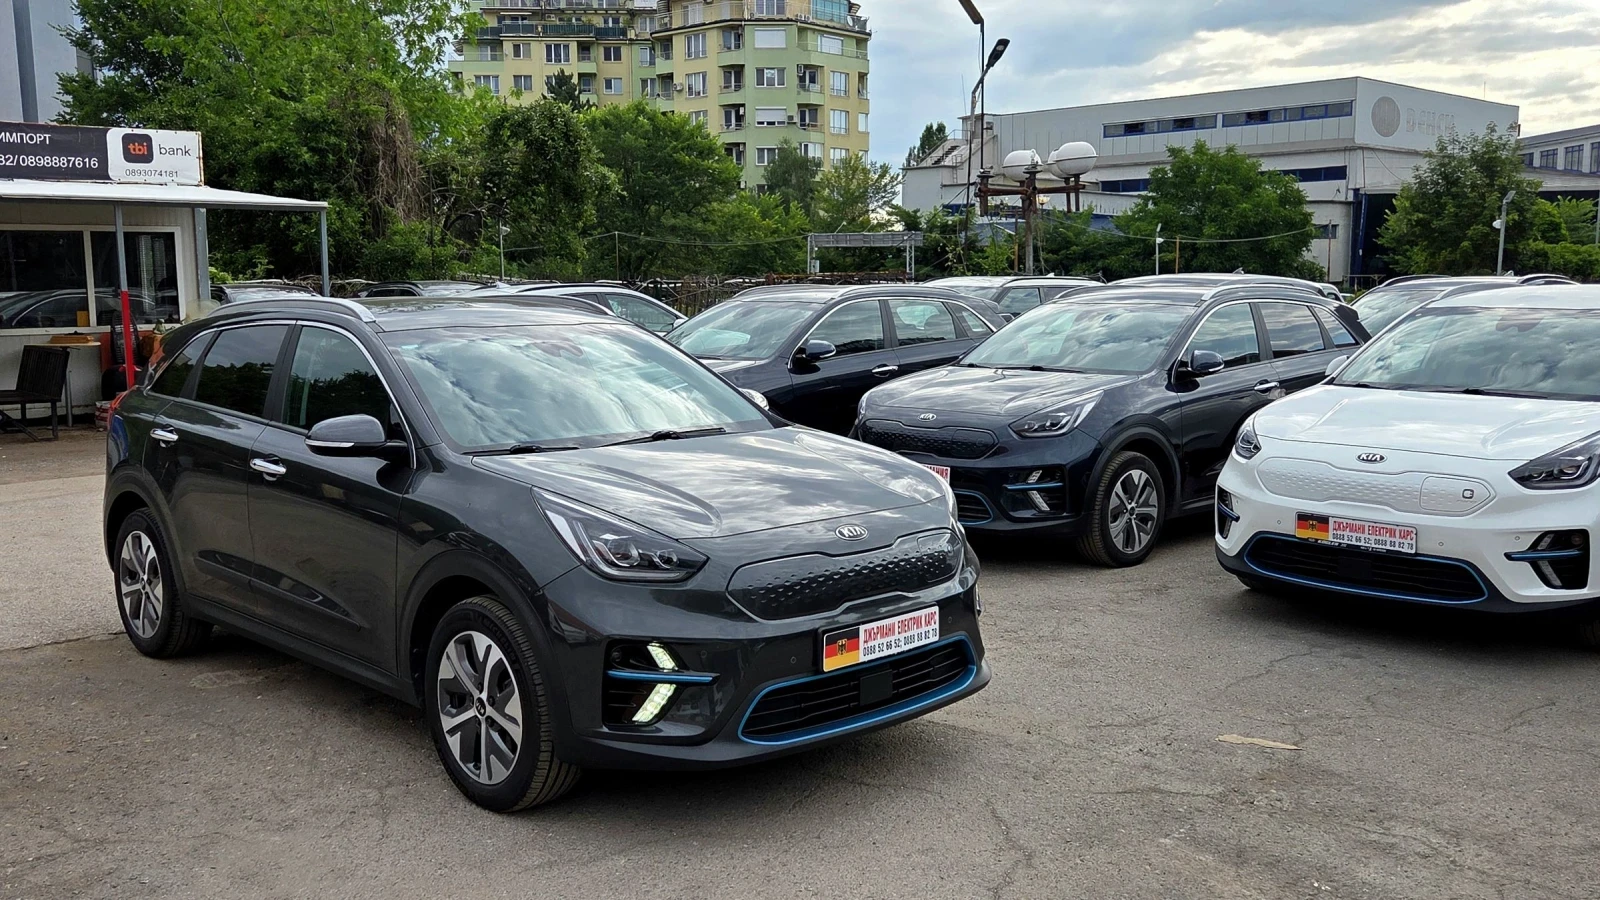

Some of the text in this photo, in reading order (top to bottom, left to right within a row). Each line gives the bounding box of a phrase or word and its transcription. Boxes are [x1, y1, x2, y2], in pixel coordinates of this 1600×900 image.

[128, 142, 191, 157] tbi bank
[125, 168, 178, 178] 0893074181
[839, 525, 866, 538] KIA
[1333, 520, 1414, 541] ДЖЪРМАНИ ЕЛЕКТРИК КАРС
[1332, 533, 1345, 541] 0888
[1347, 534, 1354, 542] 52
[1374, 538, 1388, 547] 0888
[1389, 540, 1396, 548] 88
[1398, 541, 1405, 549] 82
[1407, 542, 1414, 550] 78
[863, 611, 937, 644] ДЖЪРМАНИ ЕЛЕКТРИК КАРС
[863, 645, 876, 657] 0888
[877, 642, 885, 653] 52
[886, 641, 893, 651] 66
[904, 635, 916, 646] 0888
[916, 632, 923, 642] 88
[924, 630, 931, 640] 82
[931, 628, 938, 638] 78
